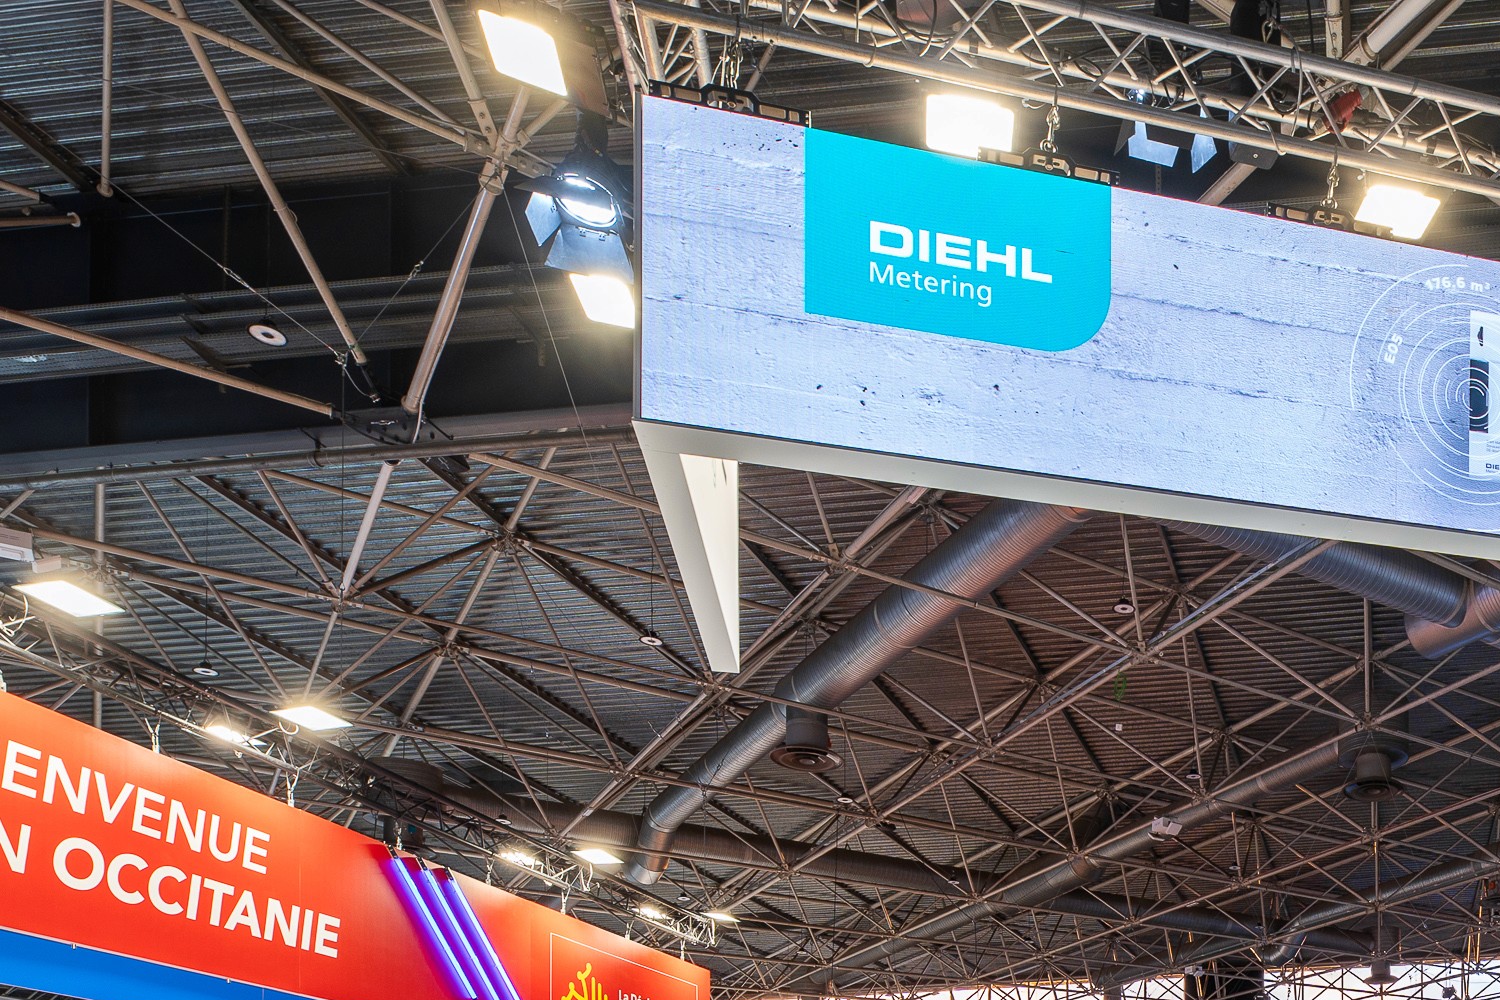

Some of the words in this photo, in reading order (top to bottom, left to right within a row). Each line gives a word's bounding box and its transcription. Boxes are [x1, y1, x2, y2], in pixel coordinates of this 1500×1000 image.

[870, 220, 1053, 284] DIEHL
[870, 261, 992, 308] Metering
[1, 740, 271, 874] ENVENUE
[52, 837, 341, 958] OCCITANIE
